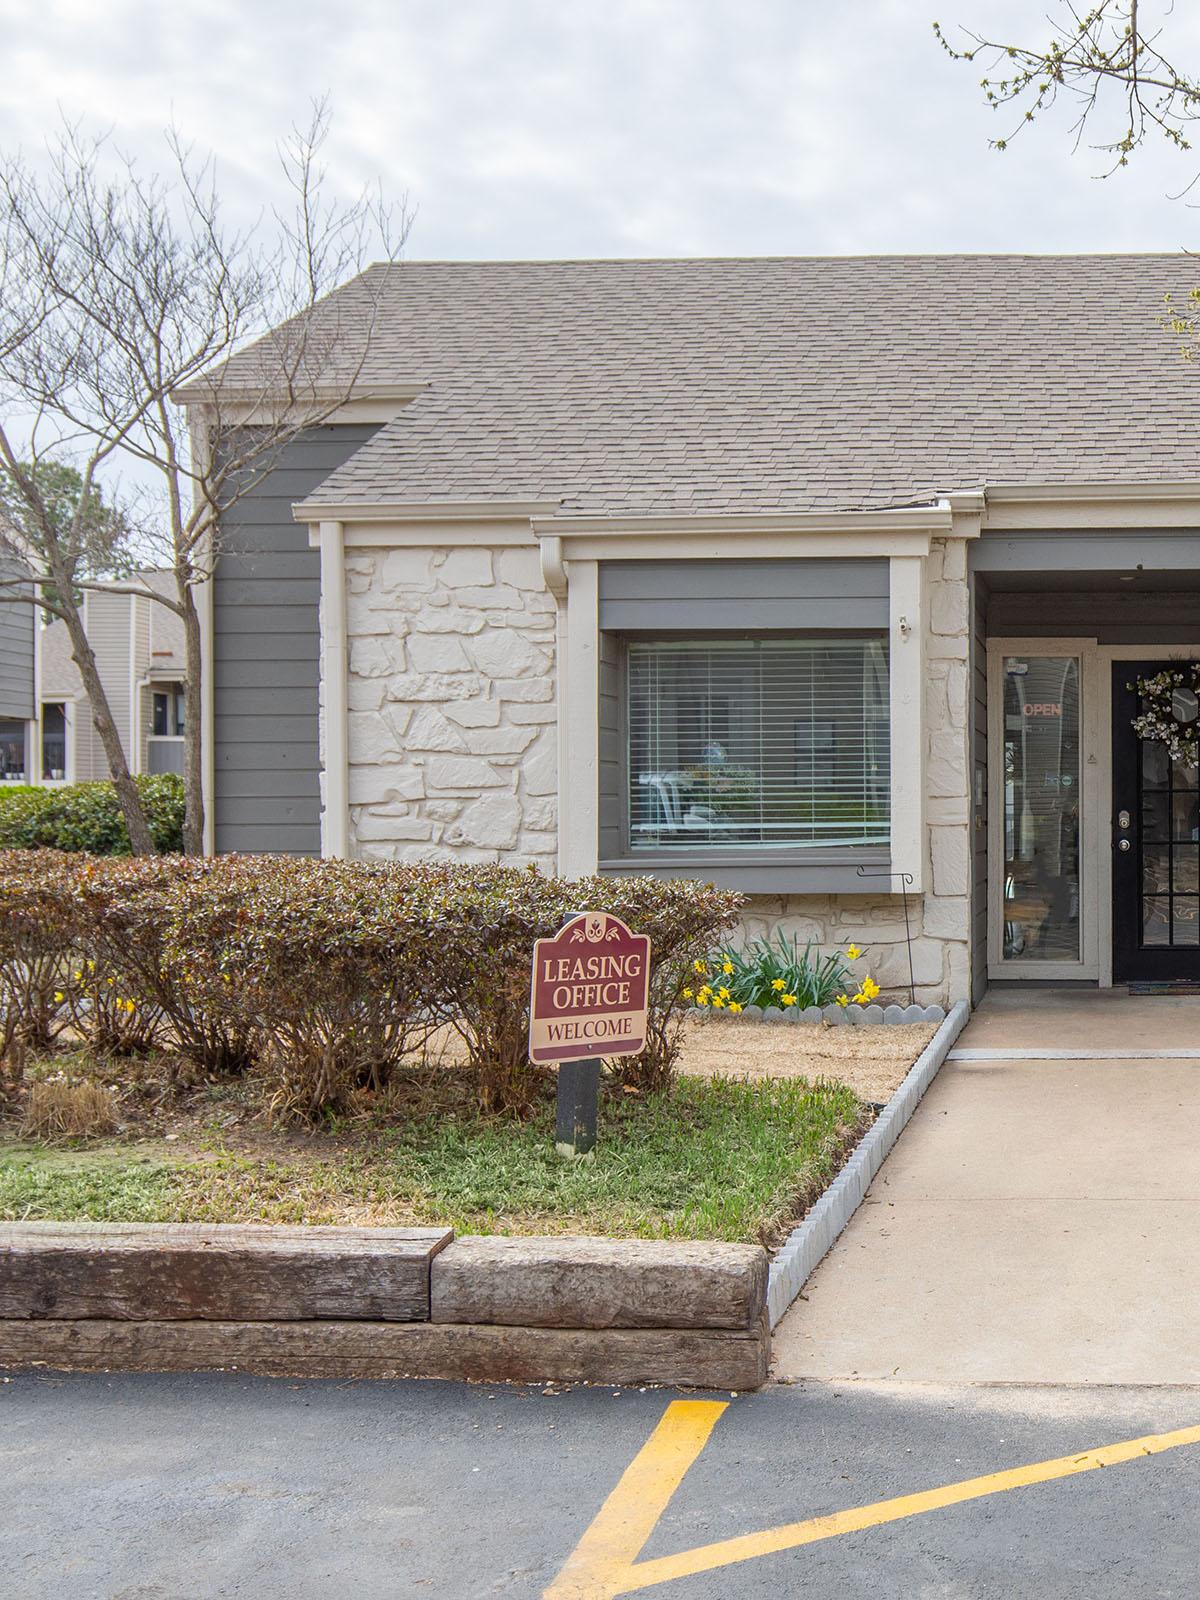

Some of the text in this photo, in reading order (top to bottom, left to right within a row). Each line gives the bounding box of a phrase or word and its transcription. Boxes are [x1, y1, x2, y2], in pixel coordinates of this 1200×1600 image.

[1024, 704, 1062, 716] OPEN
[543, 954, 641, 983] LEASING
[553, 982, 630, 1009] OFFICE
[547, 1018, 632, 1041] WELCOME
